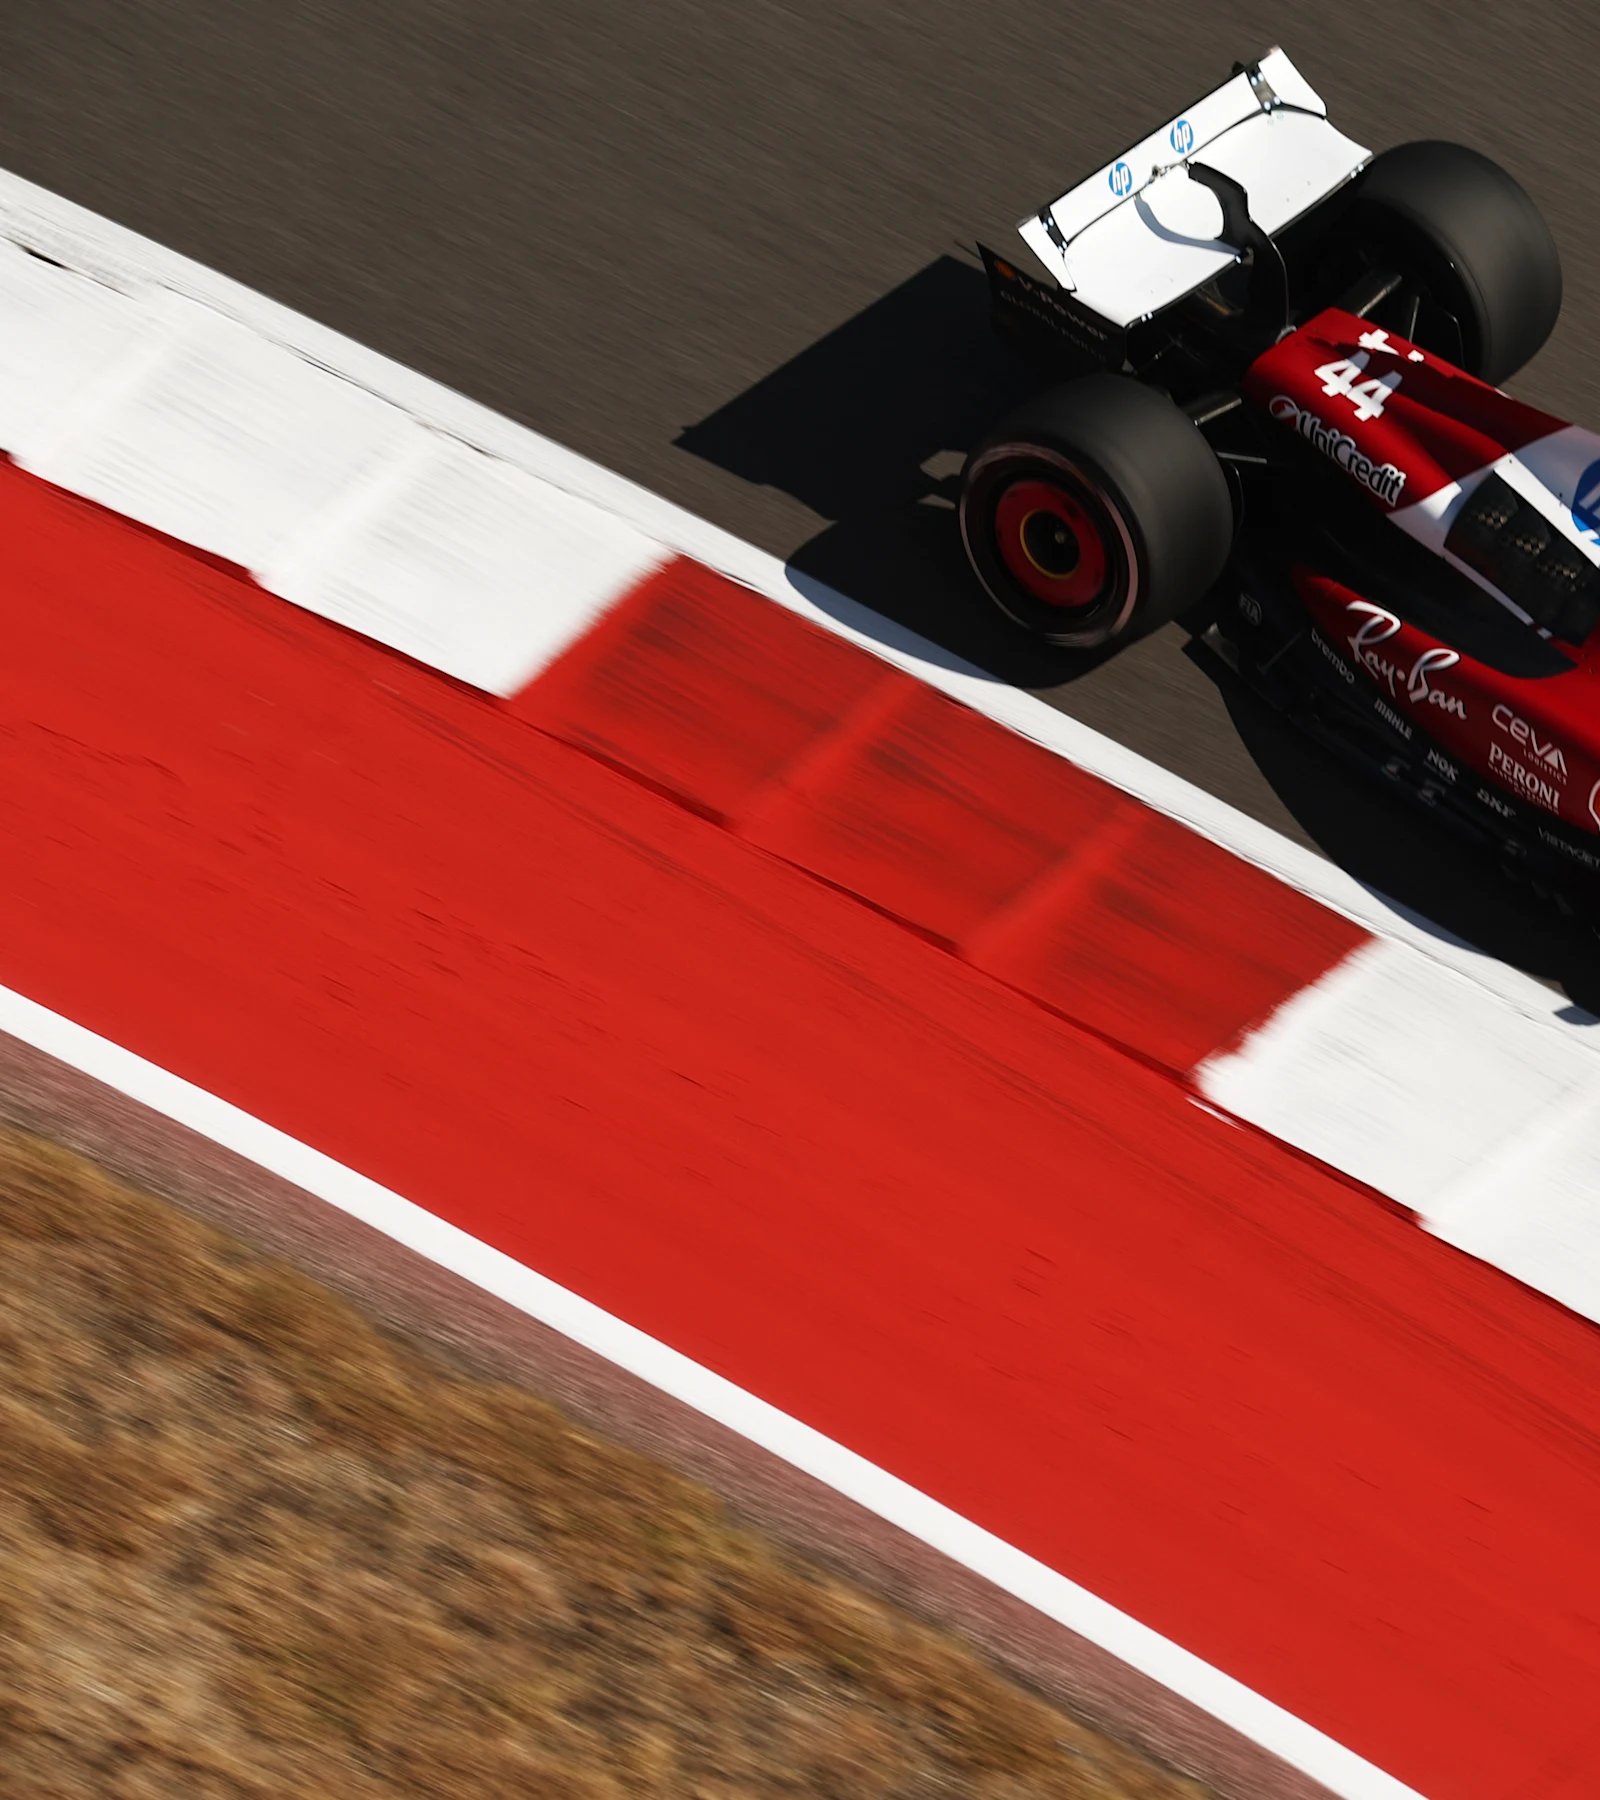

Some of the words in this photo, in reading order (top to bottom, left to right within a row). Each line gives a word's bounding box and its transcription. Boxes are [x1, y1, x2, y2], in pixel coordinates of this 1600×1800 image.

[1170, 119, 1195, 155] hp
[1108, 162, 1133, 197] hp
[1314, 350, 1403, 422] 44
[1298, 409, 1407, 508] UniCredit
[1311, 627, 1356, 685] brembo
[1373, 697, 1413, 740] MAHLE
[1426, 748, 1460, 783] NOK
[1488, 740, 1561, 810] PERONI
[1476, 788, 1517, 819] SKF
